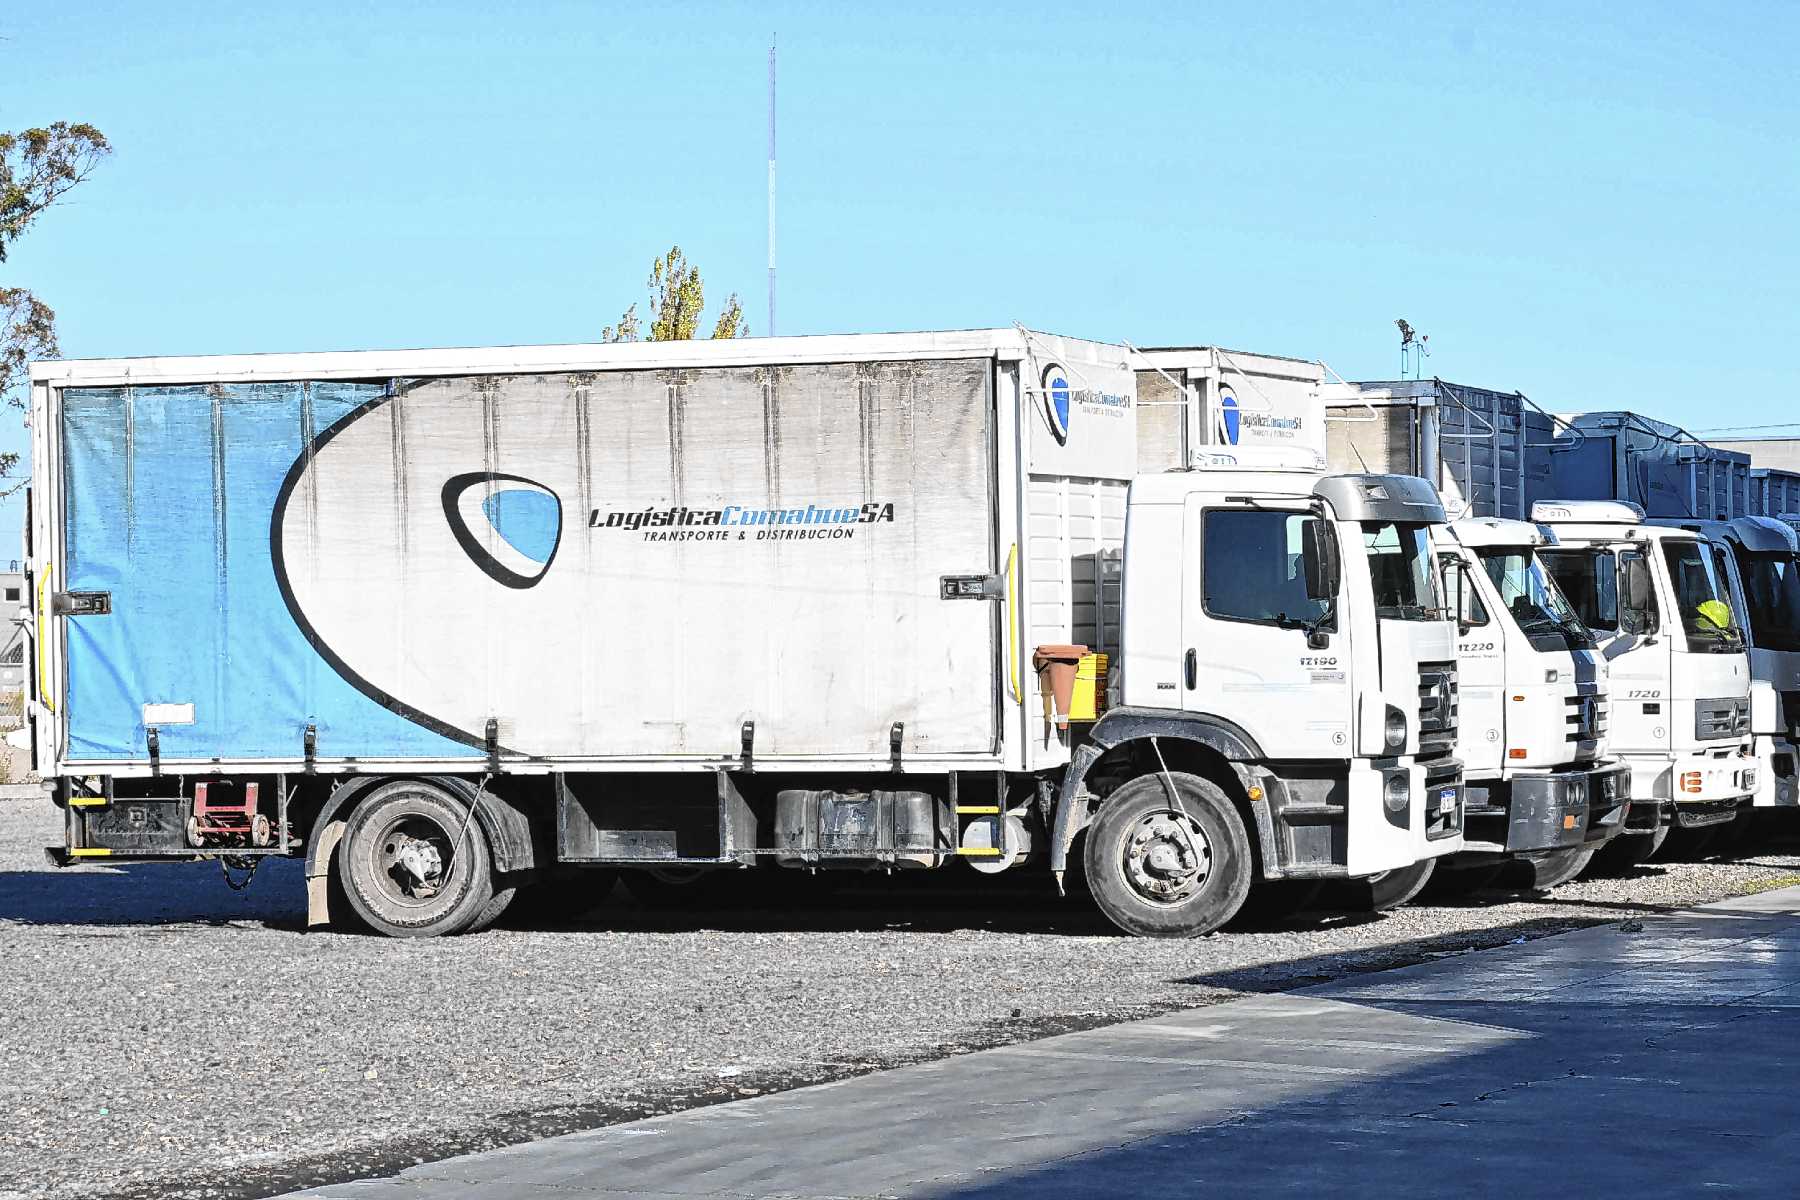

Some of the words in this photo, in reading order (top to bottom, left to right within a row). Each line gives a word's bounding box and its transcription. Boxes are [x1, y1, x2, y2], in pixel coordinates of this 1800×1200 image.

[643, 531, 729, 542] TRANSPORTE
[738, 531, 746, 540] &
[756, 526, 854, 541] DISTRIBUCIÓN
[1628, 690, 1661, 698] 1720
